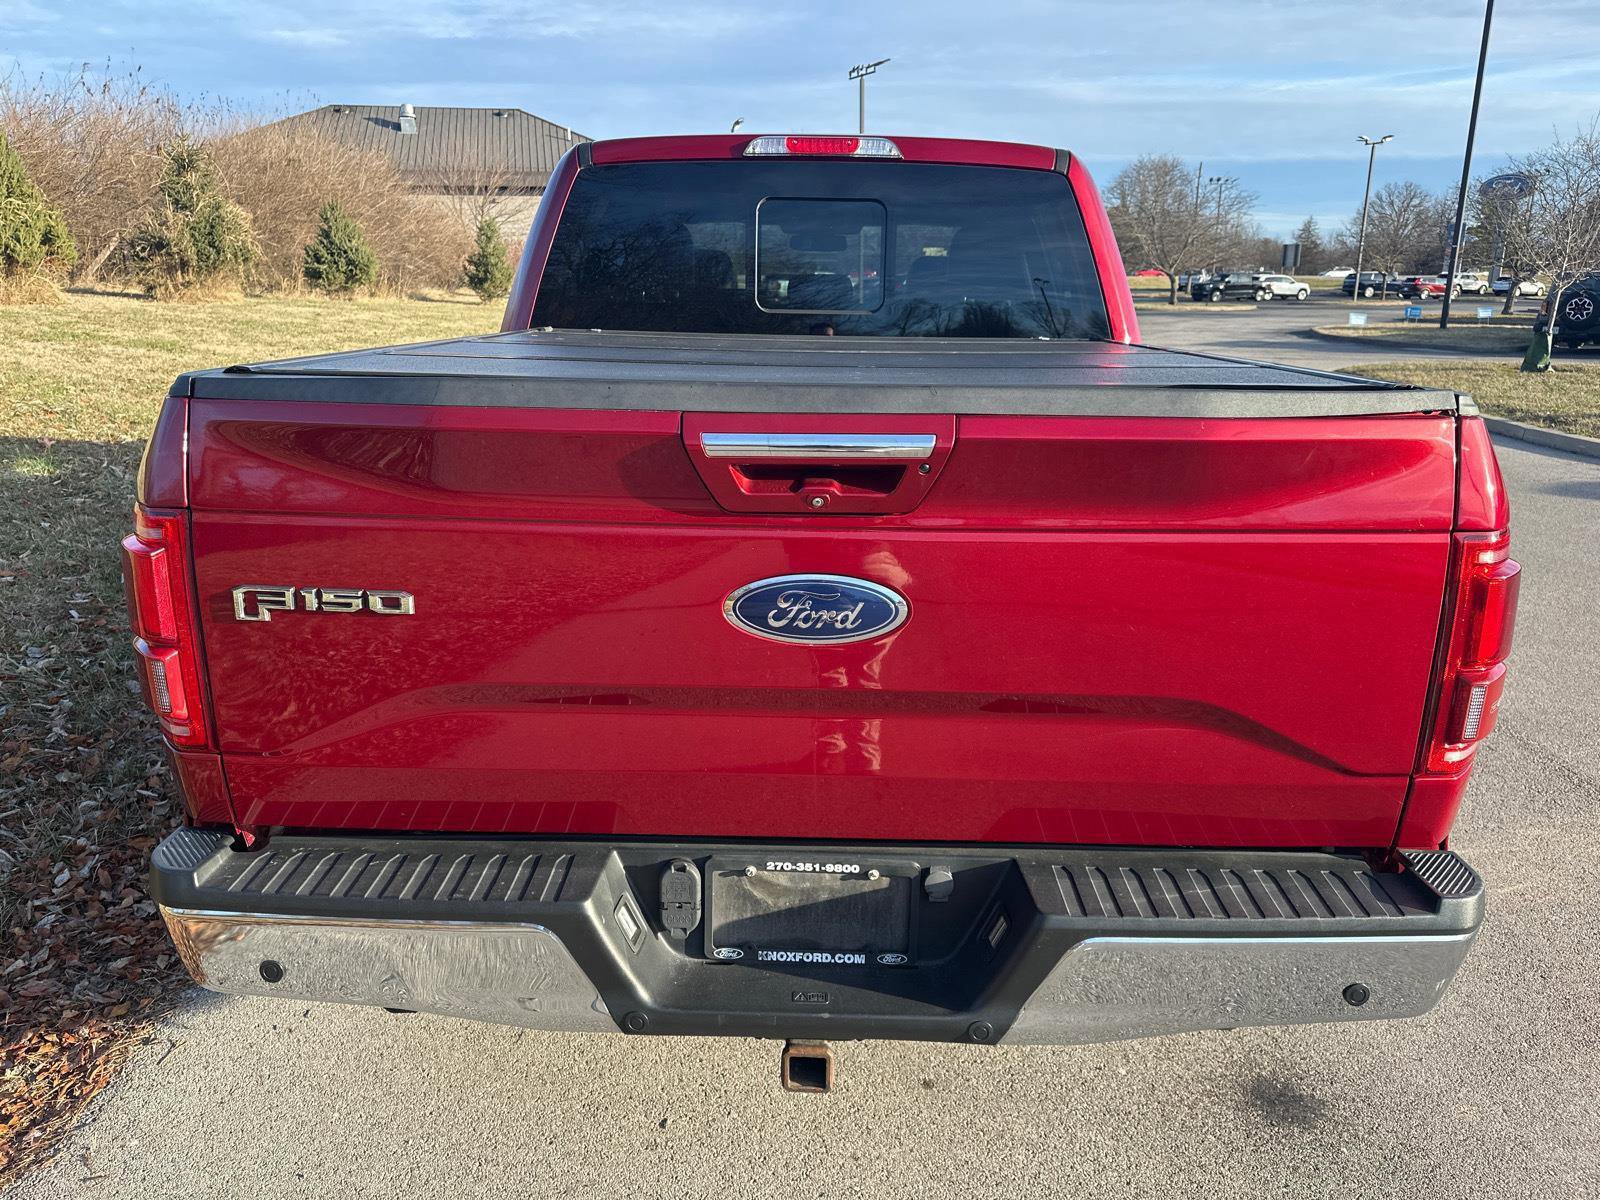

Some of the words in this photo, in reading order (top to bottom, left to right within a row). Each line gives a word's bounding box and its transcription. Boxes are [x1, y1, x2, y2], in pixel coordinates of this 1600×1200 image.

[768, 590, 865, 629] Ford
[766, 861, 860, 873] 270-351-9800
[757, 950, 866, 964] KNOXFORD.COM
